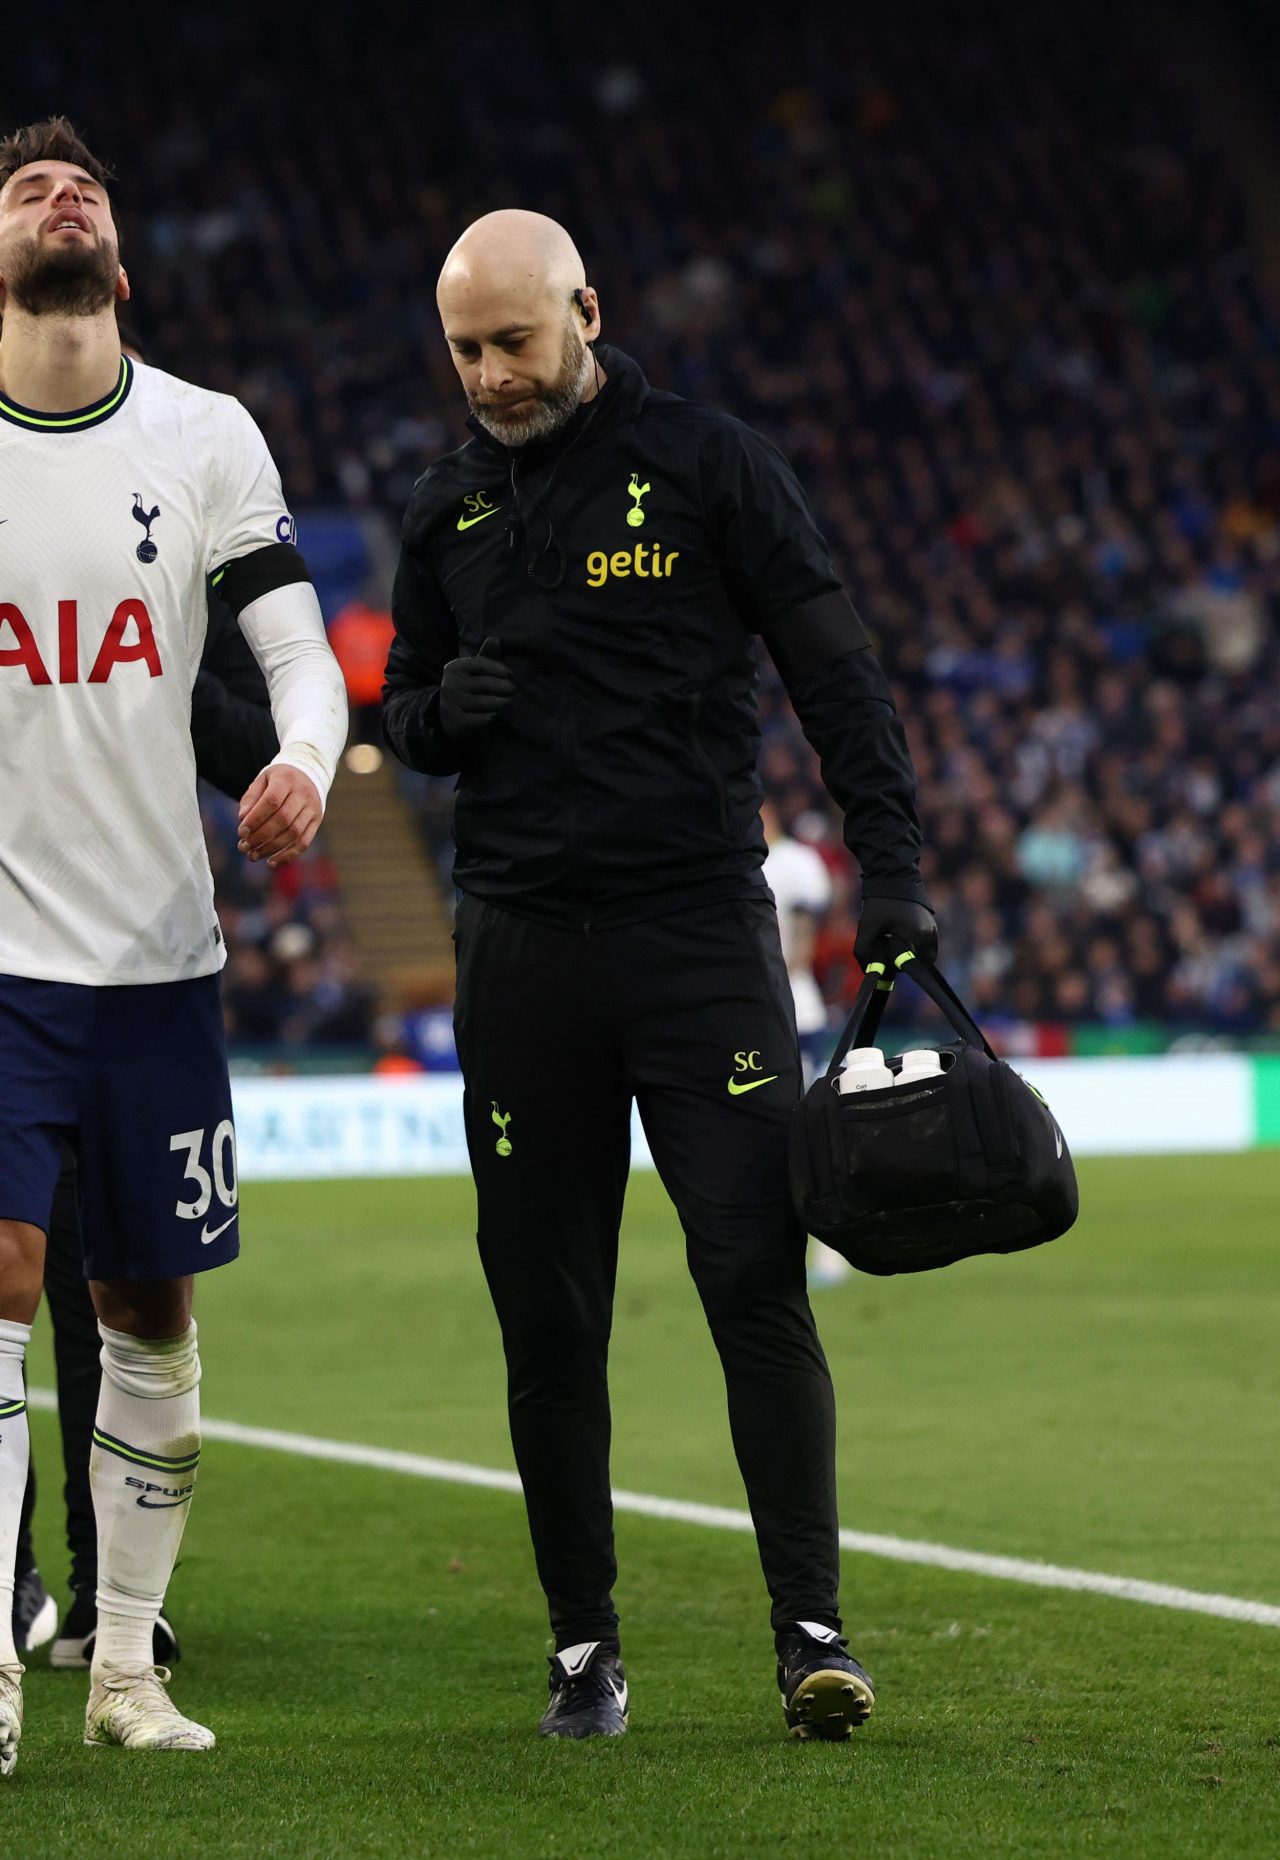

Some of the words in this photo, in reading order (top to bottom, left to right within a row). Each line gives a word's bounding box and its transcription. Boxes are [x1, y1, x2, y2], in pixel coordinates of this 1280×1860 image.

[463, 490, 493, 512] SC
[586, 543, 680, 587] getir
[734, 1050, 763, 1072] SC
[170, 1119, 238, 1220] 30
[125, 1476, 195, 1497] SPUR
